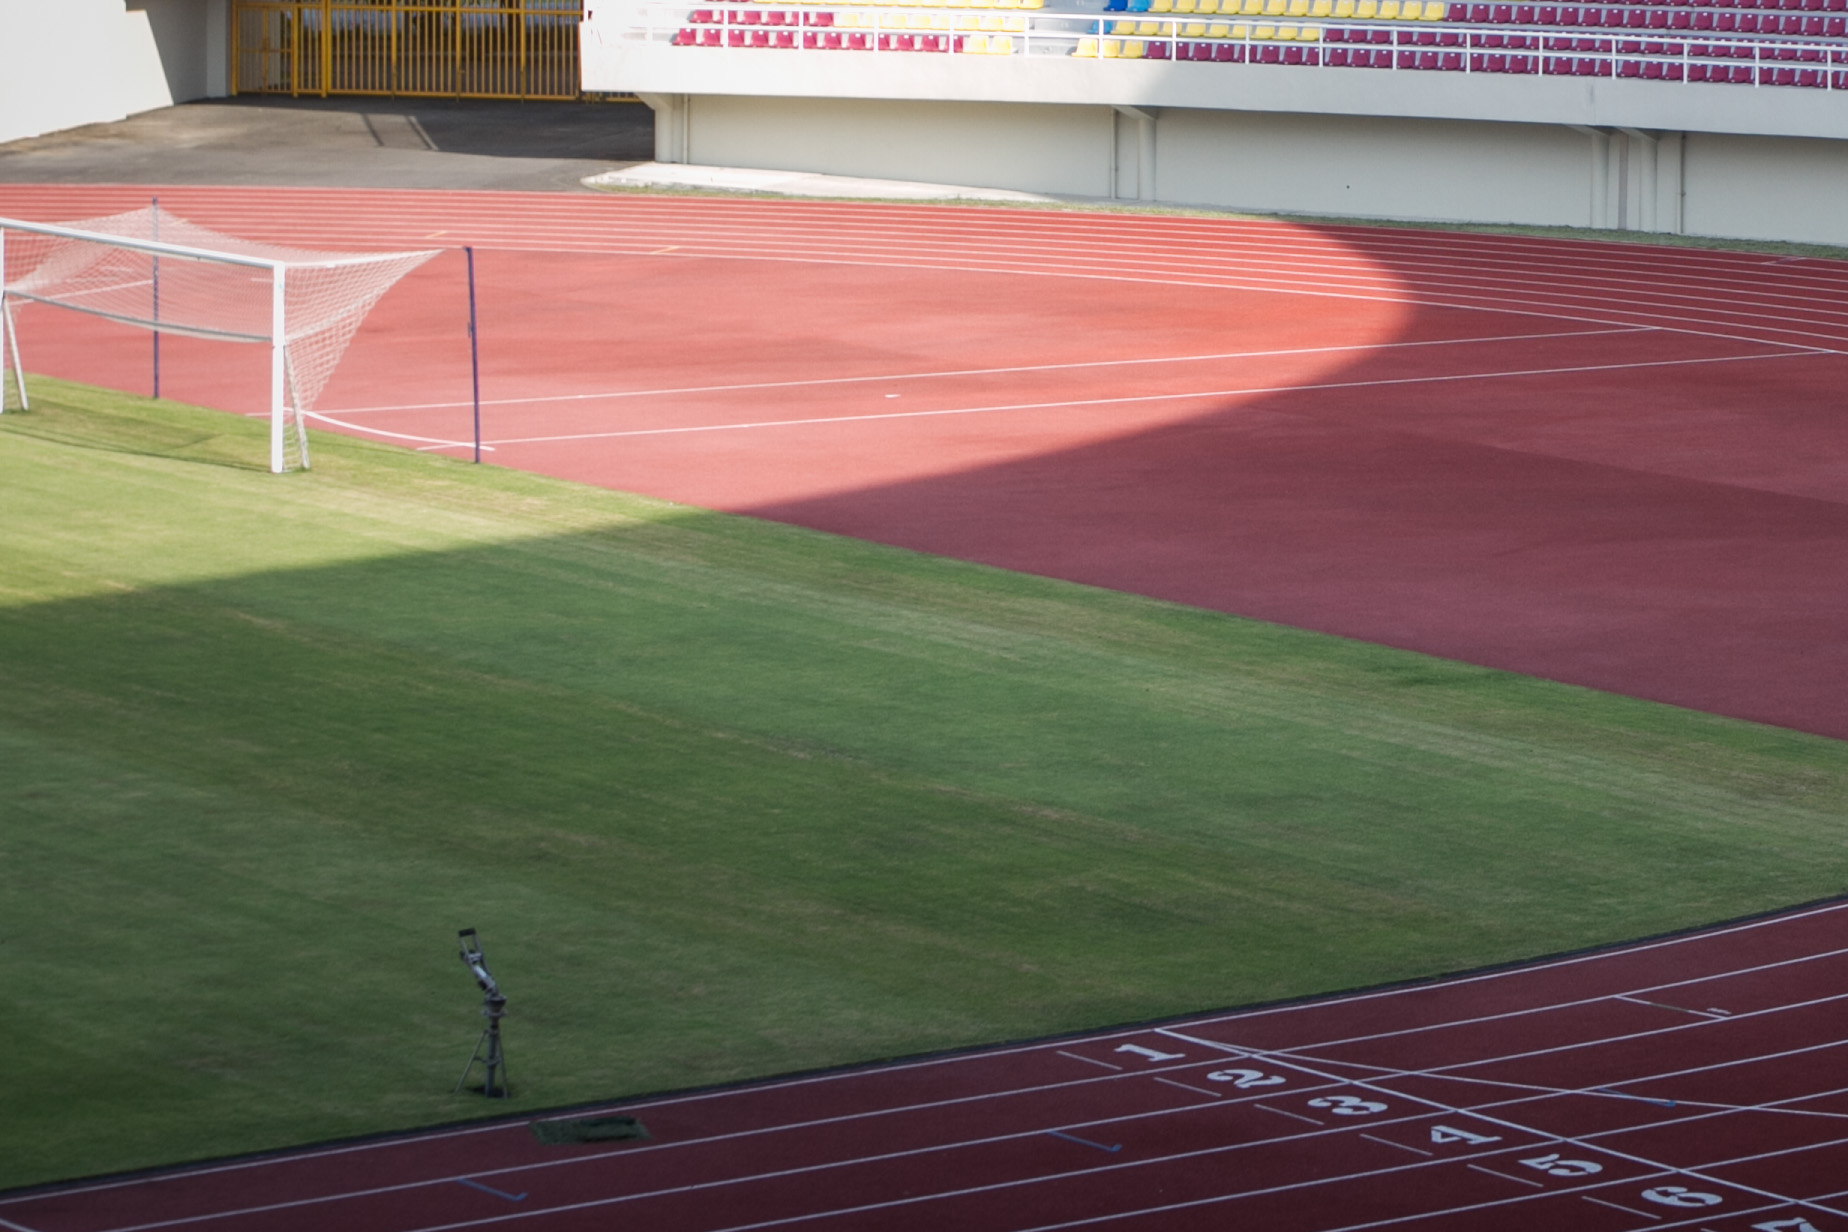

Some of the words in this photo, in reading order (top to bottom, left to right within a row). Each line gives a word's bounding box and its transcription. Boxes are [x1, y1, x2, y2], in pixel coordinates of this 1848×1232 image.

[1113, 1043, 1186, 1062] 1
[1206, 1069, 1287, 1089] 2
[1307, 1096, 1388, 1116] 3
[1431, 1125, 1503, 1145] 4
[1518, 1153, 1603, 1176] 5
[1640, 1186, 1724, 1208] 6
